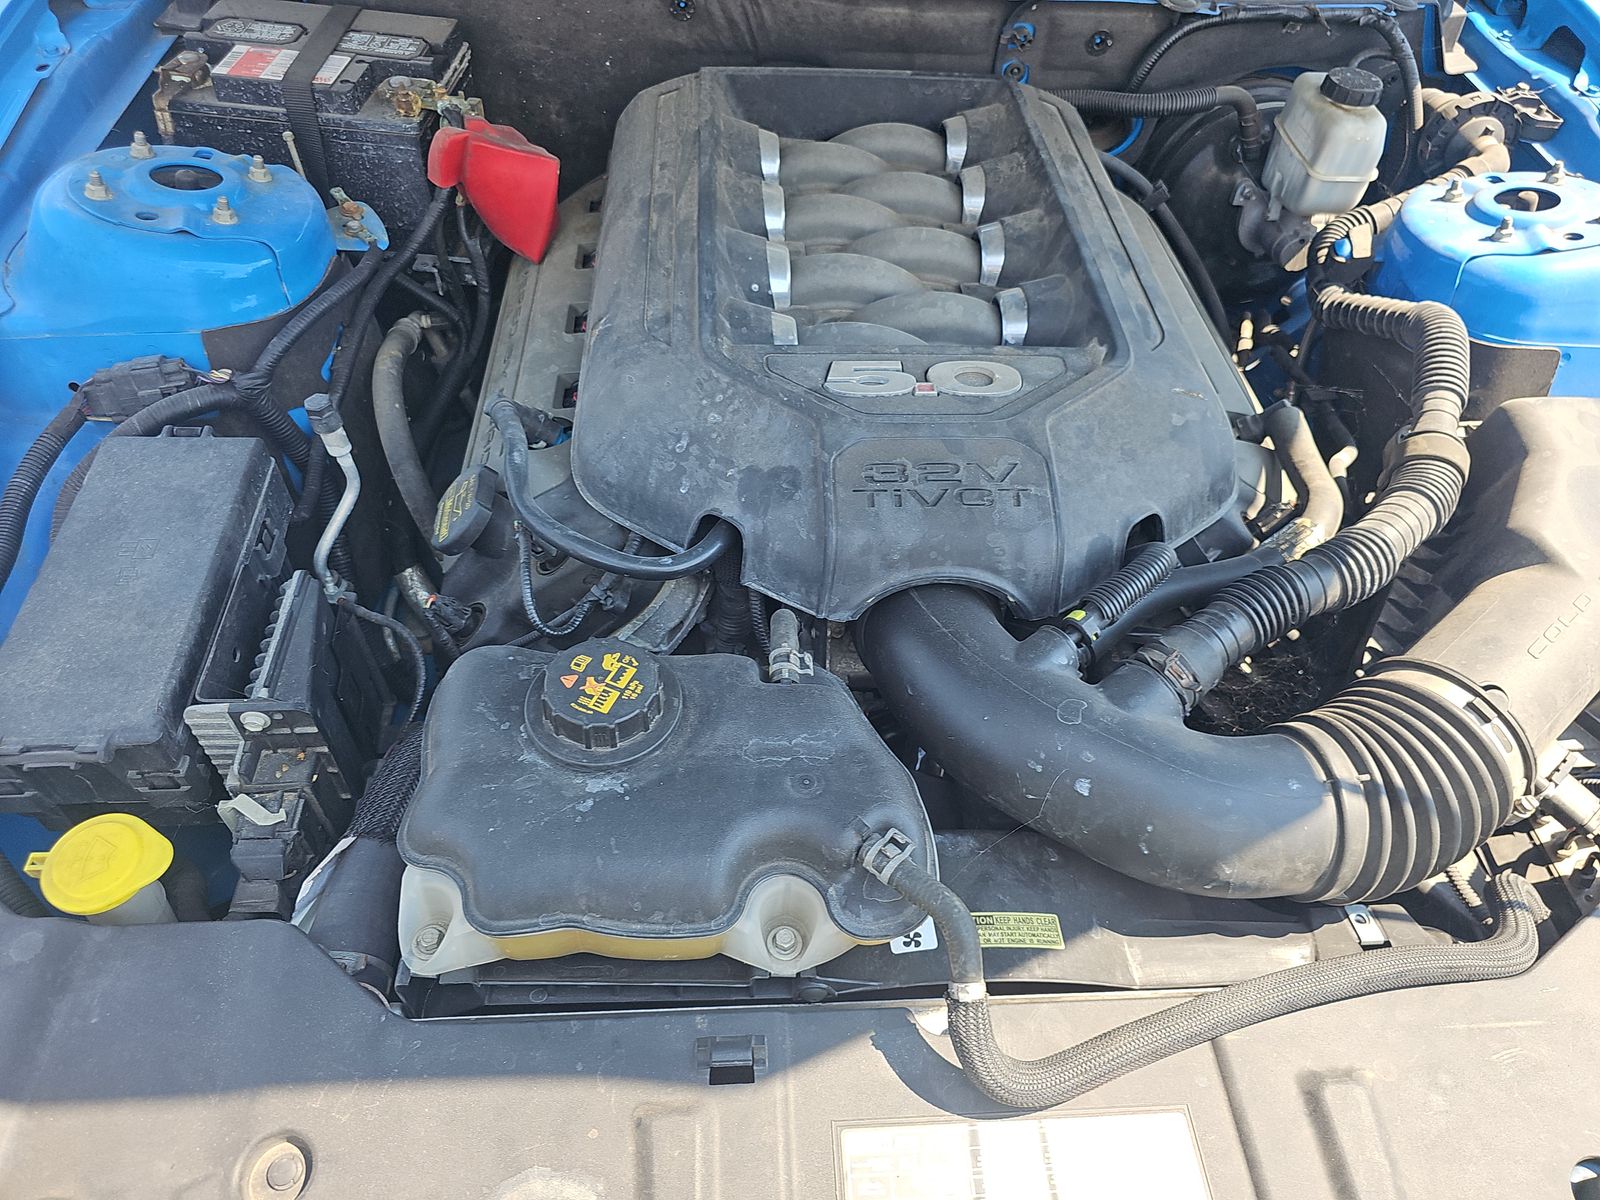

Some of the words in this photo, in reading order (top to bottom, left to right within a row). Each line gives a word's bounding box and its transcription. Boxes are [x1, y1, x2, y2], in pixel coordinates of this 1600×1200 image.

[821, 360, 1023, 397] 5.0
[862, 462, 1019, 485] 32V
[1527, 592, 1592, 659] COLD
[995, 916, 1011, 924] KEEP
[1013, 917, 1034, 925] HANDS
[1036, 917, 1056, 925] CLEAR
